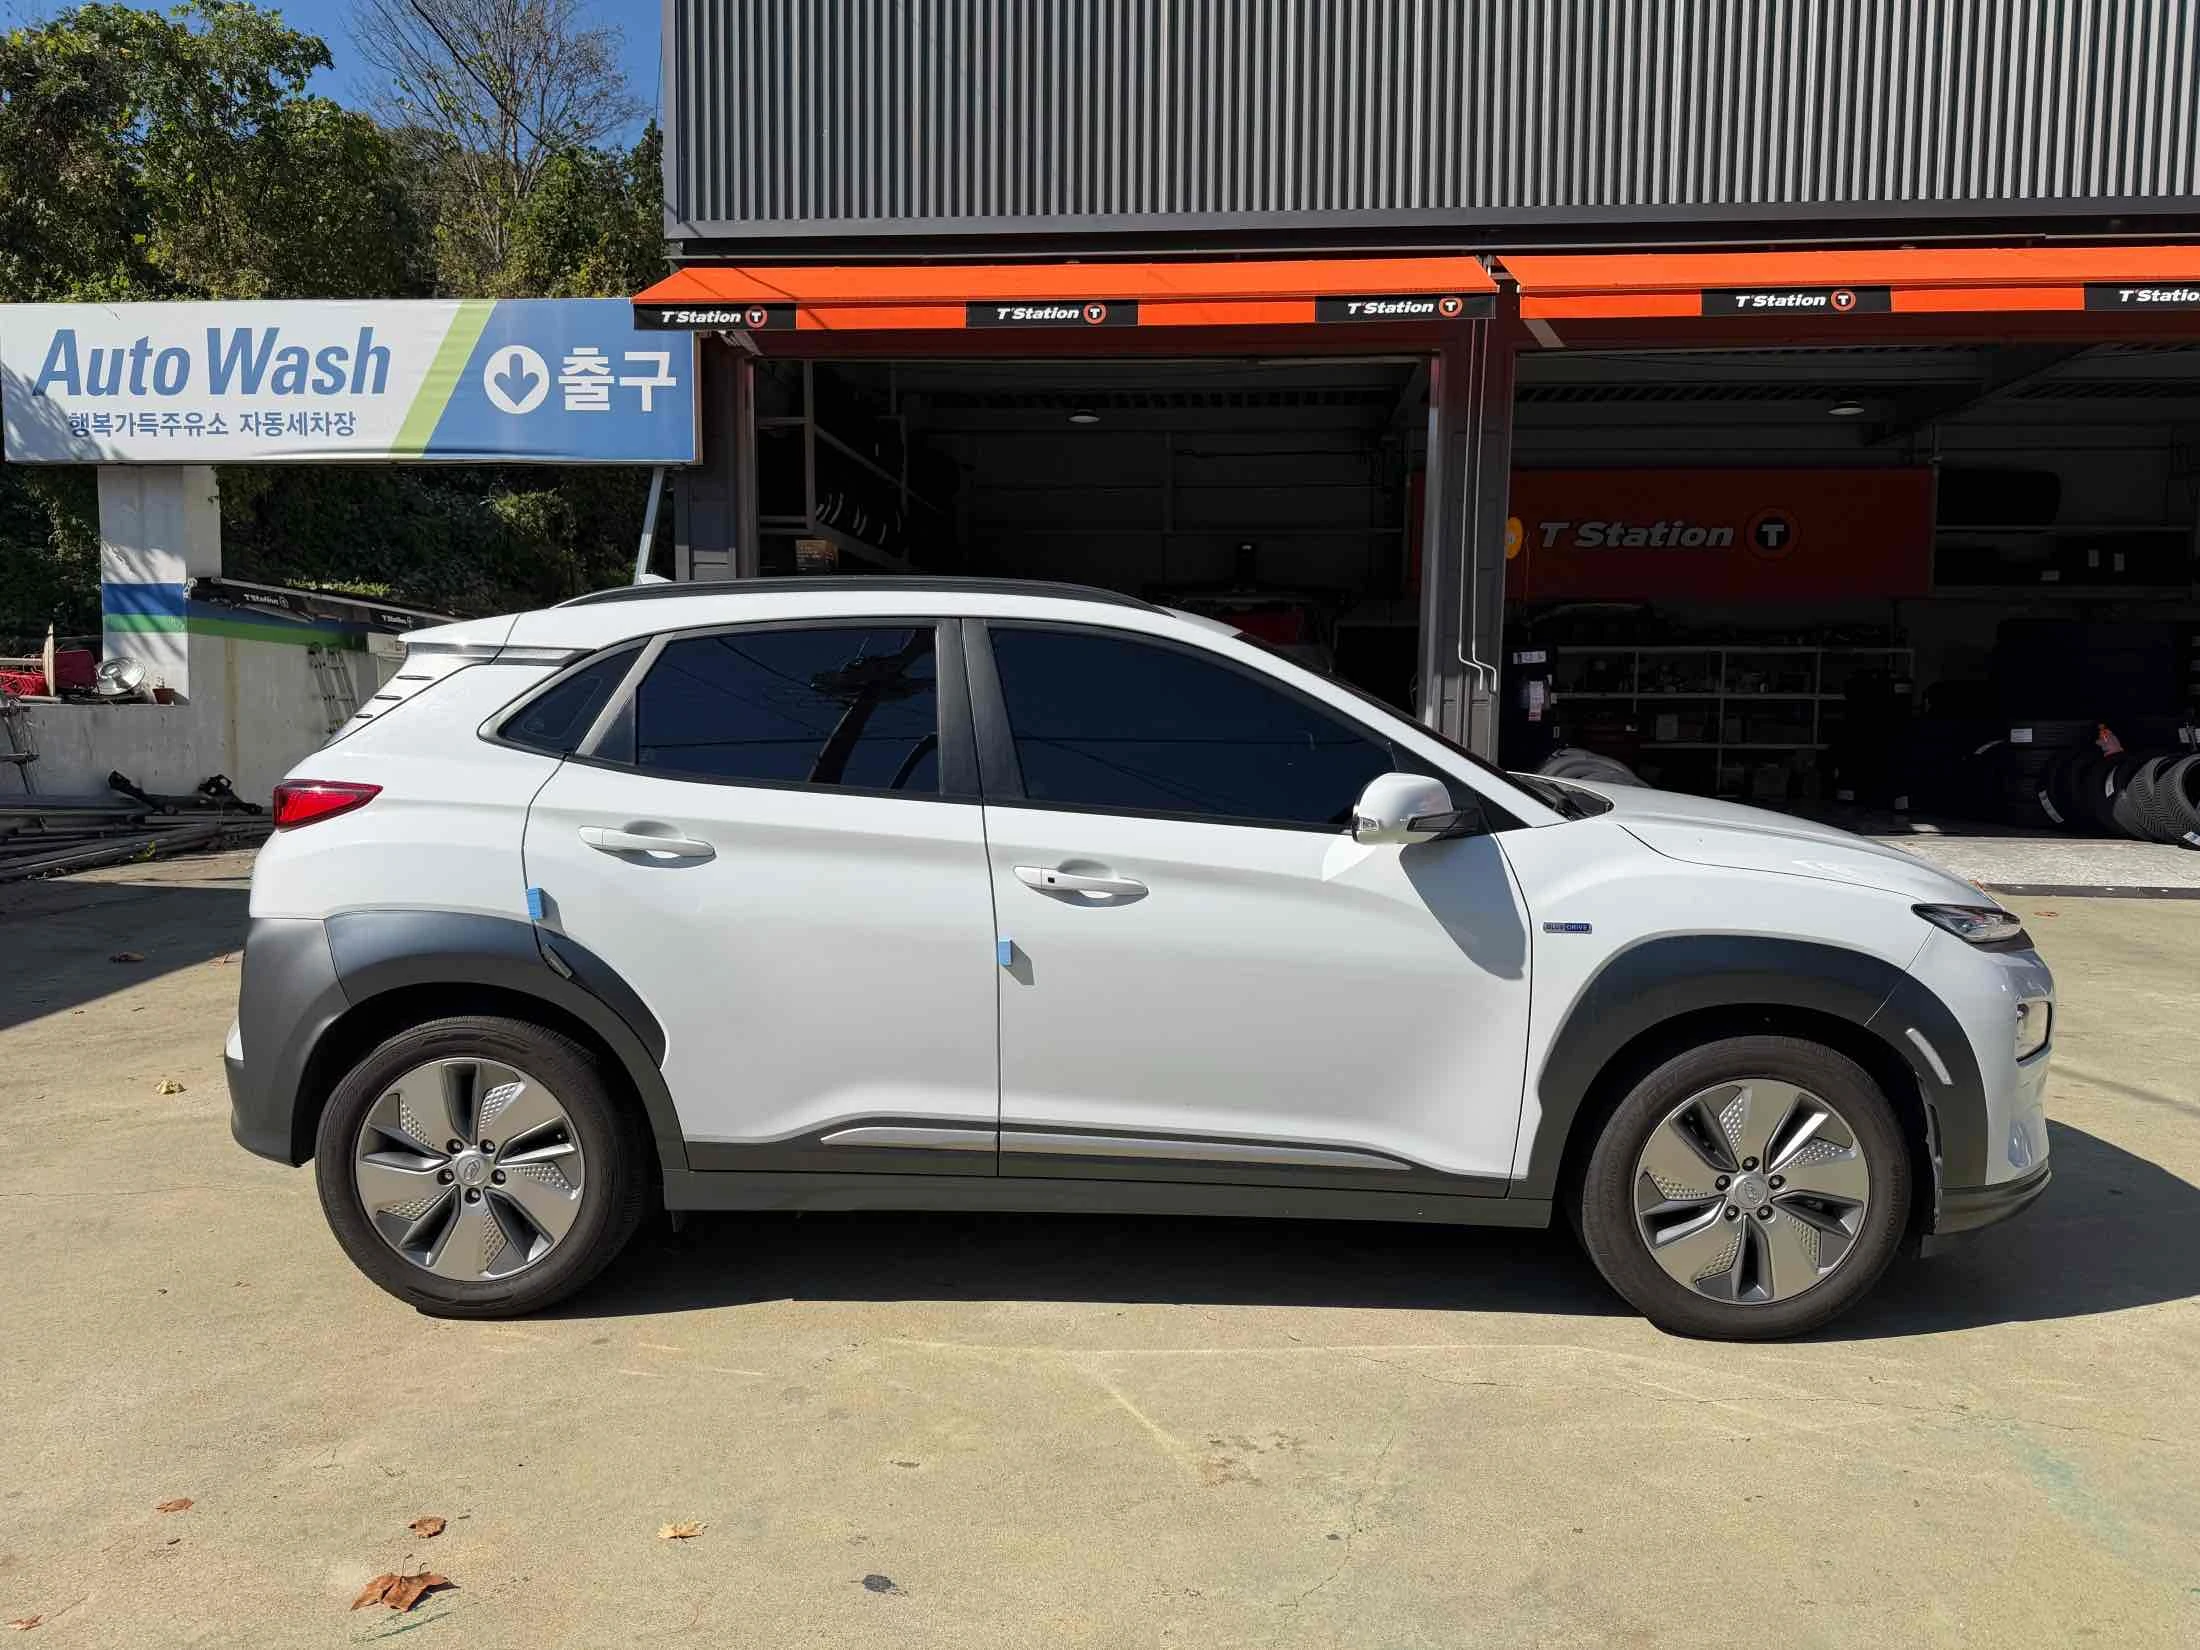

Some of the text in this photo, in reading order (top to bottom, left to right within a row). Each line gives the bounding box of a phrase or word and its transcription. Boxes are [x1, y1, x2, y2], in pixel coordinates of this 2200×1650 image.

[32, 326, 392, 397] Auto Wash
[558, 347, 677, 412] 출구
[69, 410, 357, 438] 행복가득주유소 자동세차장
